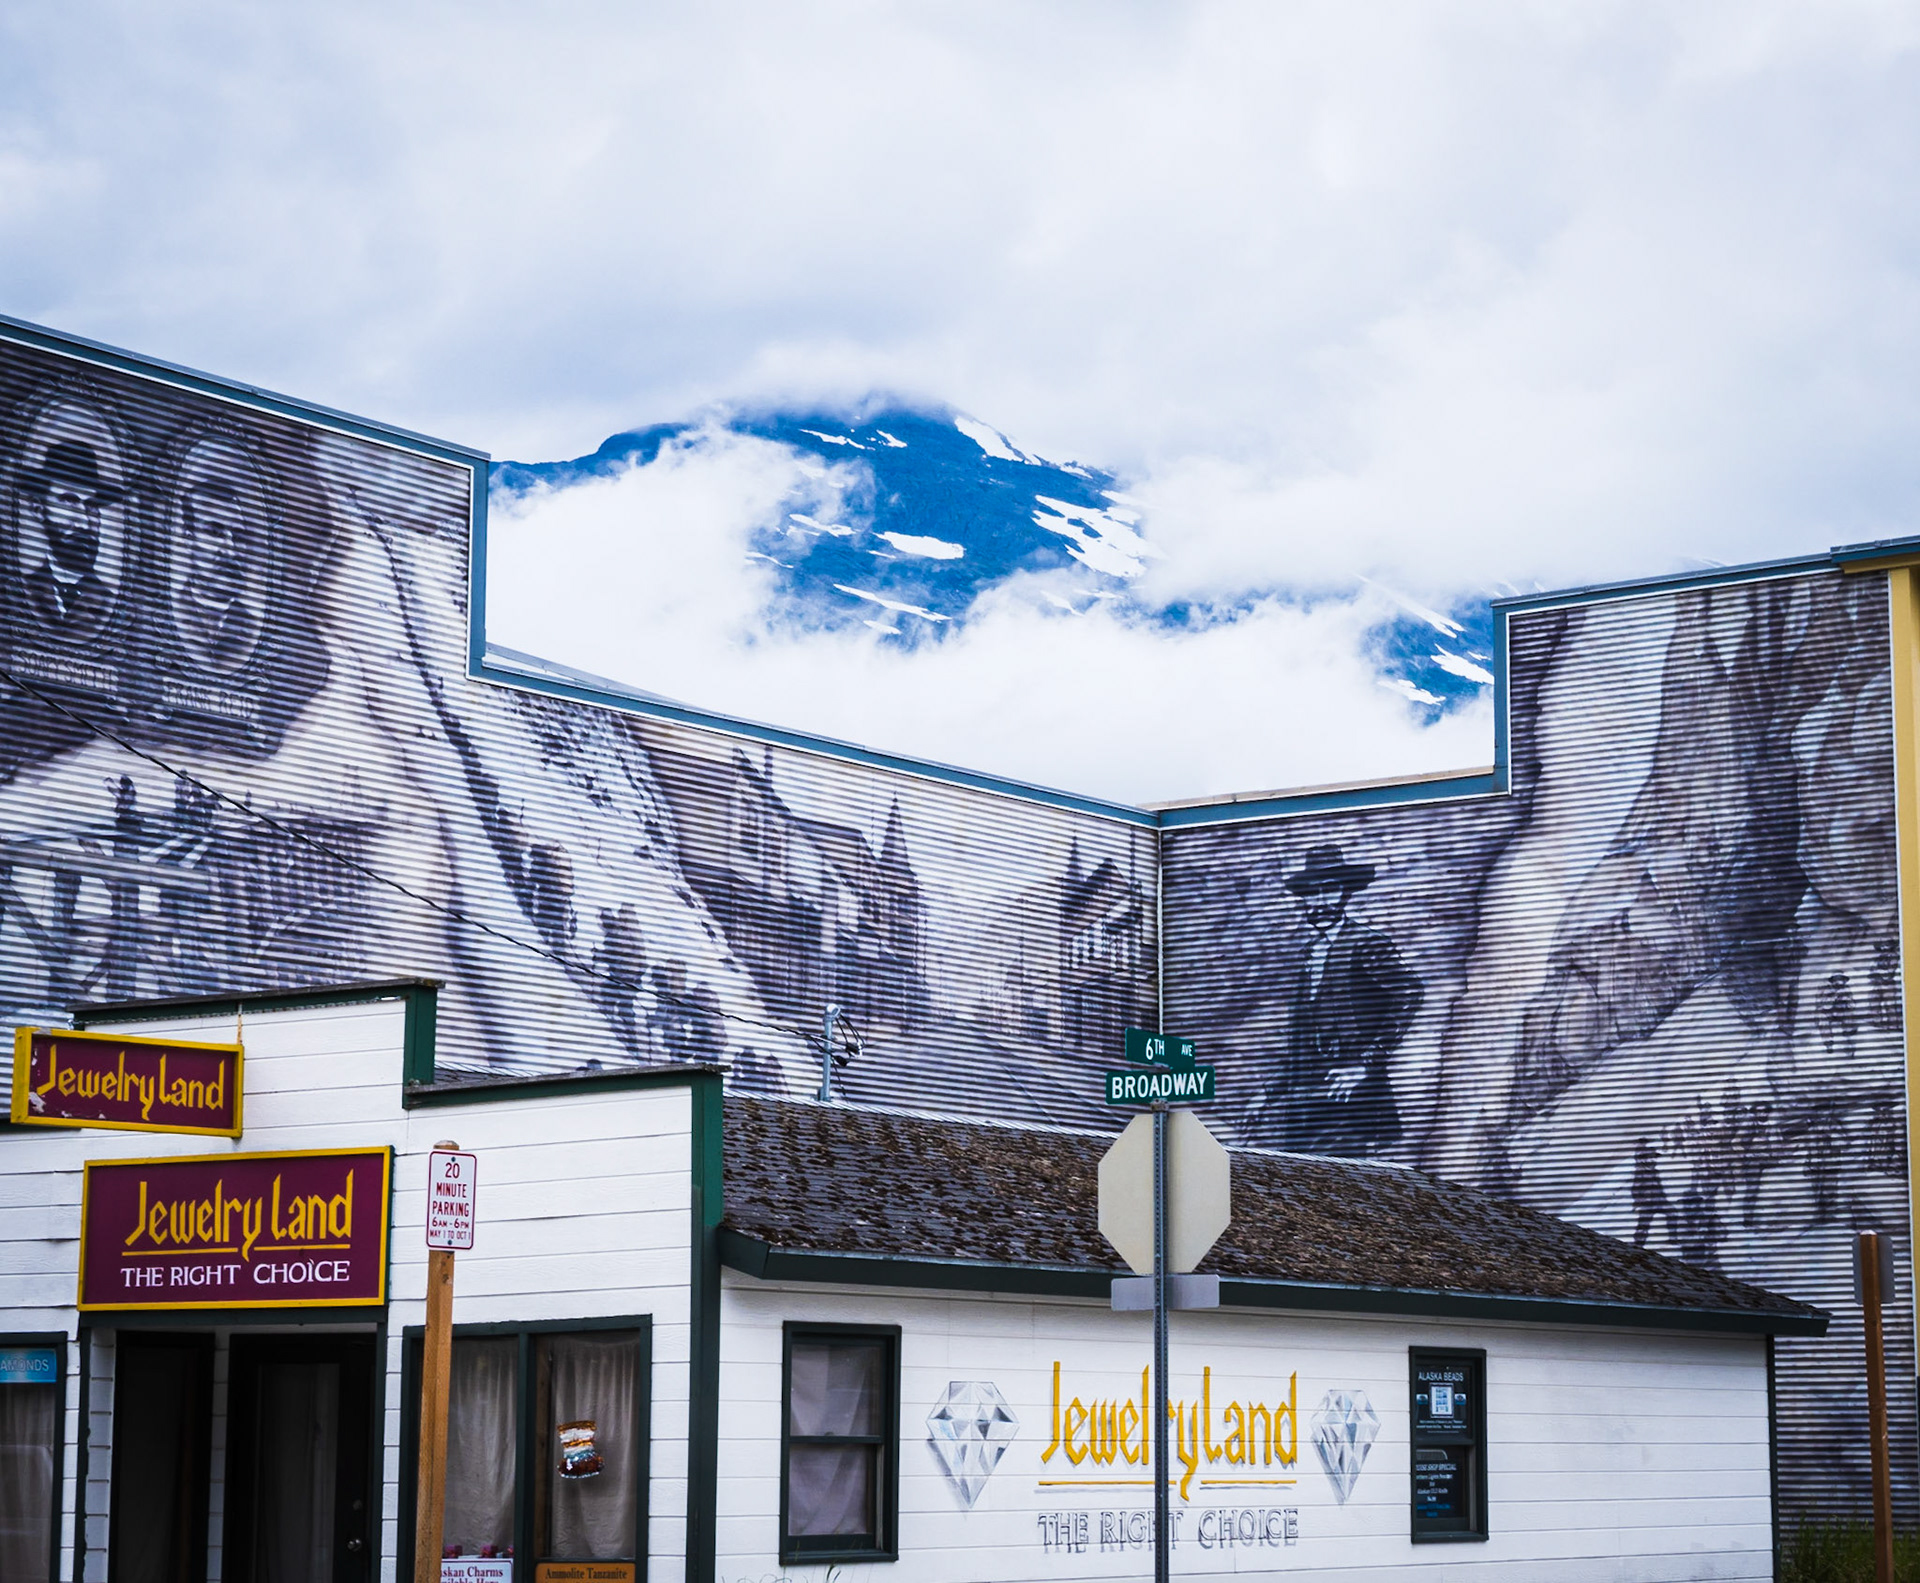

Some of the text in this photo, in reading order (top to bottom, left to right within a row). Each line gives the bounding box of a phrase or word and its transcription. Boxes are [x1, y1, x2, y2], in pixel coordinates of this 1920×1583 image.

[1145, 1037, 1193, 1060] 6TH AVE
[1111, 1071, 1208, 1099] BROADWAY
[444, 1162, 460, 1179] 20
[436, 1182, 467, 1198] MINUTE
[432, 1200, 469, 1217] PARKING
[432, 1216, 448, 1227] 6AM
[454, 1217, 469, 1229] 6PM
[430, 1230, 441, 1238] MAY
[447, 1230, 455, 1239] TO
[456, 1231, 467, 1240] OCT
[121, 1258, 351, 1287] THE RIGHT CHOICE
[1418, 1372, 1464, 1382] ALASKA BEADS
[1038, 1511, 1089, 1549] THE
[1198, 1508, 1299, 1545] CHOICE
[441, 1566, 503, 1577] skan Charms
[545, 1567, 627, 1579] Ammolite Tanzanite
